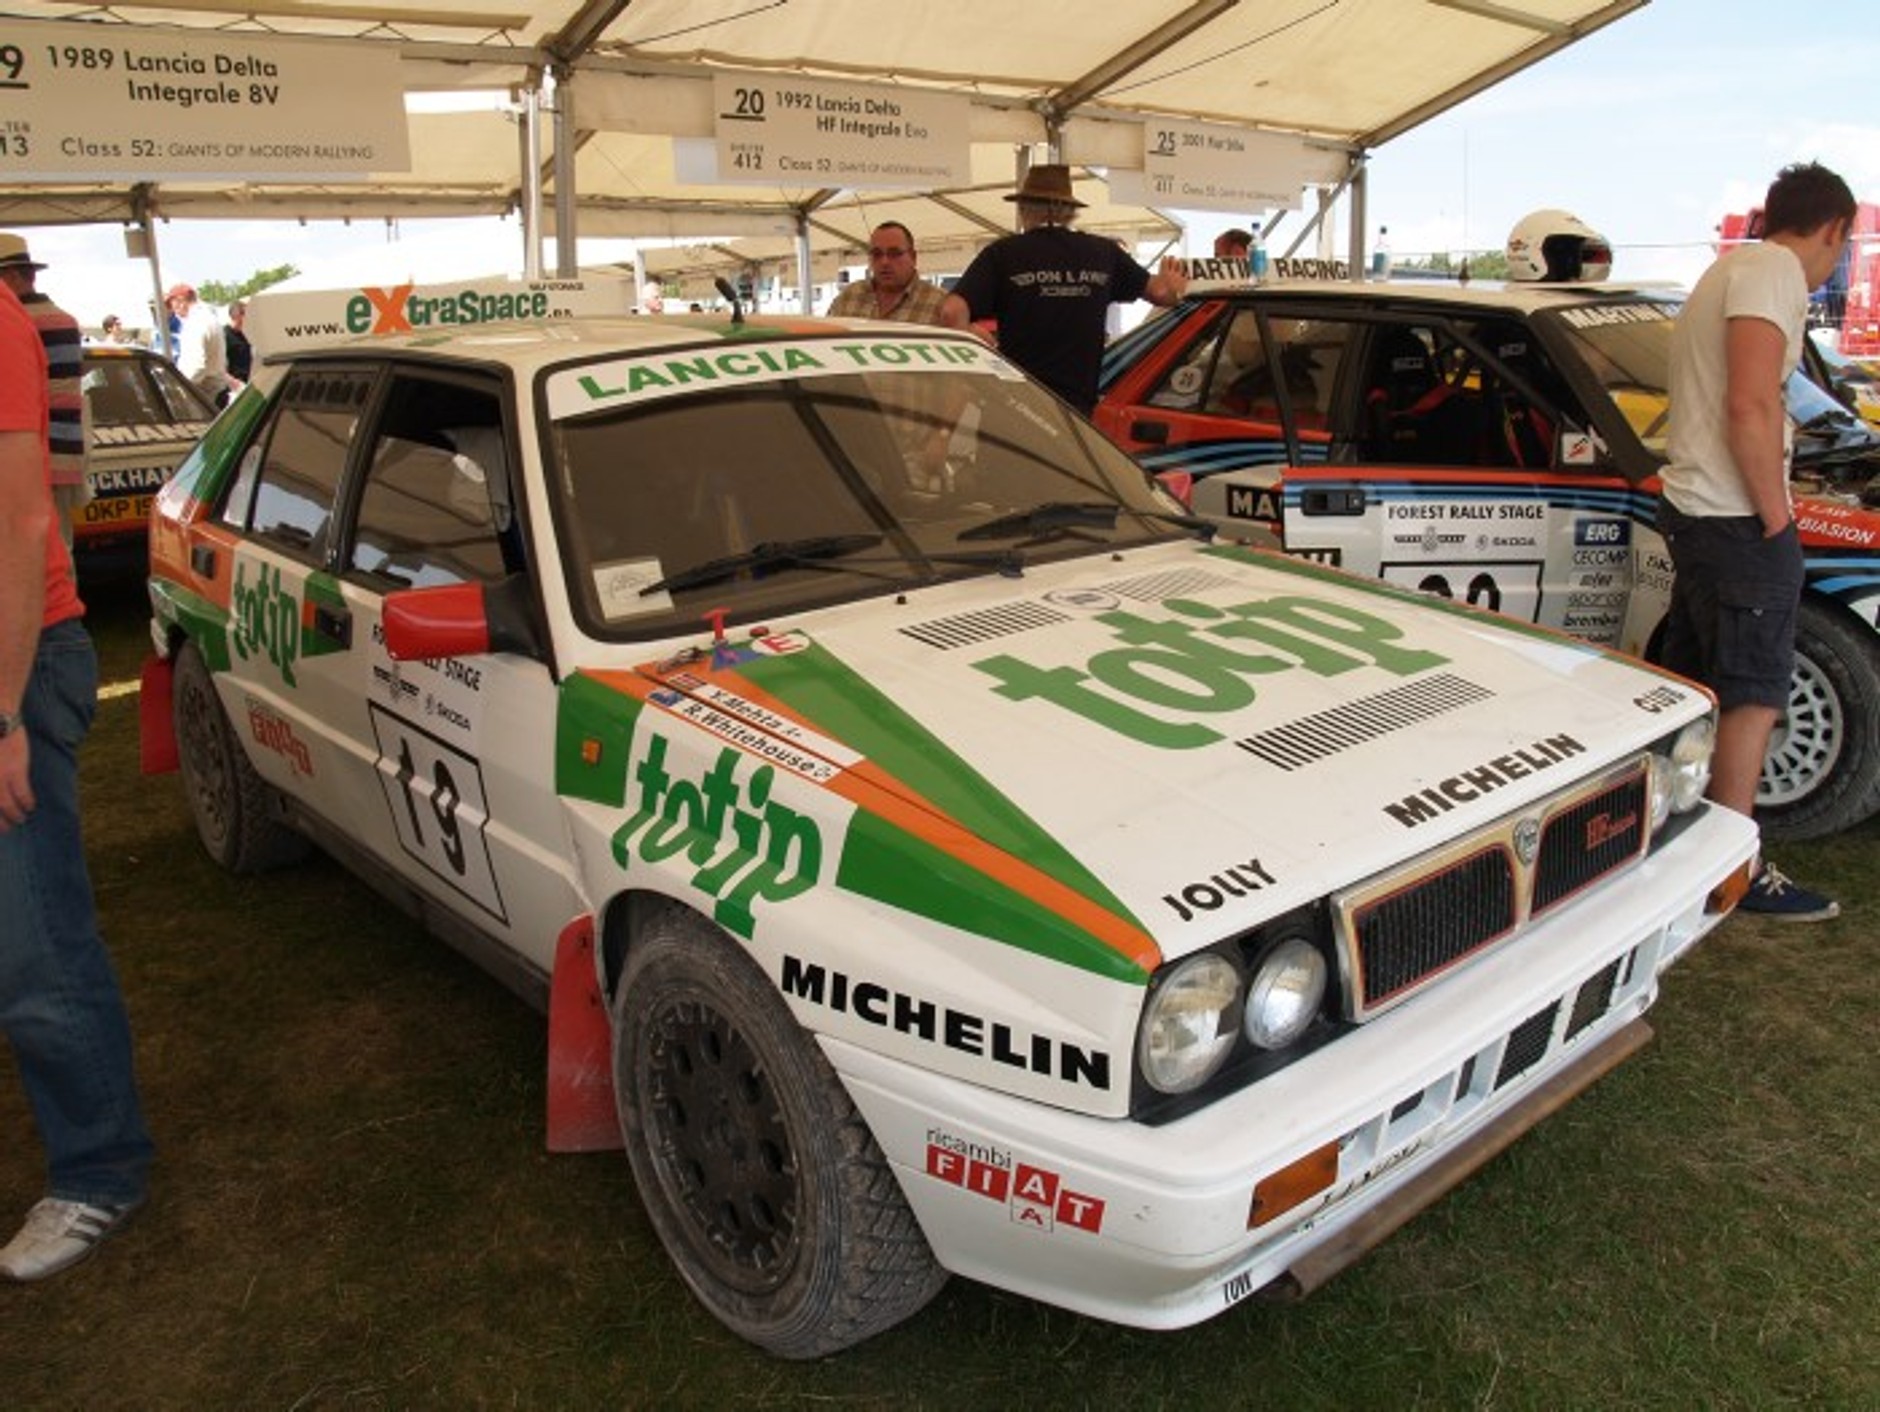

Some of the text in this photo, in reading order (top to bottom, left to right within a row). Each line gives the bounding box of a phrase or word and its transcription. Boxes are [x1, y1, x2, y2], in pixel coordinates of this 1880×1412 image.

[47, 45, 278, 77] 1989 Lancia Delta
[128, 79, 280, 108] Integrale 8V
[735, 88, 765, 114] 20
[776, 91, 902, 117] 1992 Lancia Delta
[817, 117, 928, 139] HF Integrale Evo
[1158, 132, 1176, 152] 25
[61, 137, 374, 161] Class 52: GIANTS OF MODERN RALLYING
[734, 154, 763, 170] 412
[779, 156, 813, 172] Class
[1274, 258, 1348, 280] RACING
[577, 343, 981, 400] LANCIA TOTIP
[1388, 505, 1544, 519] FOREST RALLY STAGE
[1584, 523, 1620, 541] ERG
[232, 562, 297, 688] totip
[969, 594, 1453, 750] totip
[1382, 732, 1586, 829] MICHELIN
[397, 737, 467, 876] 19
[611, 732, 822, 941] totip
[1162, 858, 1277, 922] JOLLY
[781, 954, 1110, 1092] MICHELIN
[927, 1127, 1012, 1169] ricambi
[932, 1148, 1102, 1230] FIAT
